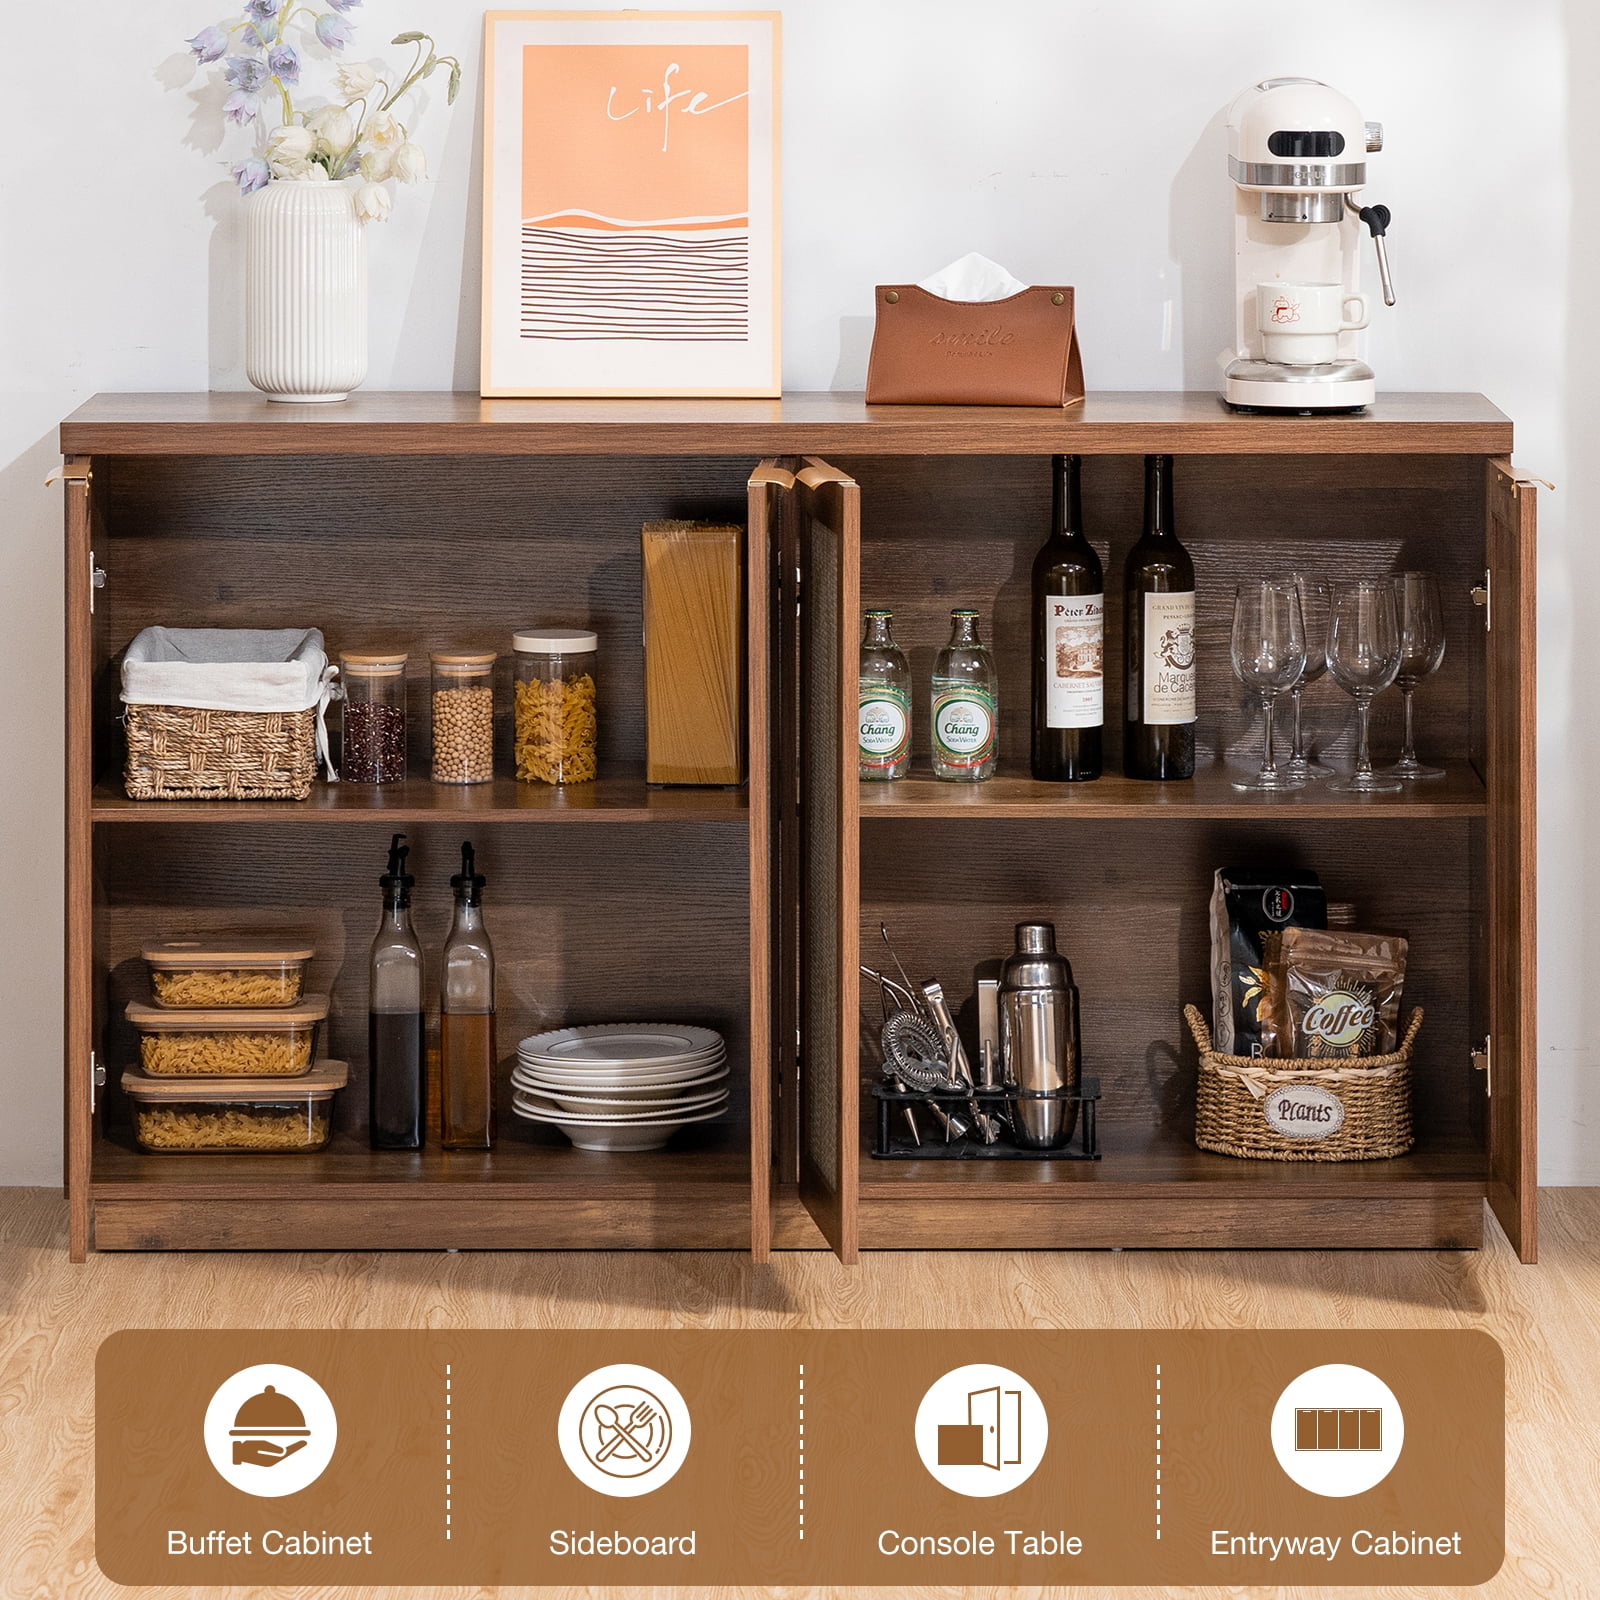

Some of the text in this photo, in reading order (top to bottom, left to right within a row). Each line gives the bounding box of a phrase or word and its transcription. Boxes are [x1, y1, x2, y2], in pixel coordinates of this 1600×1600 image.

[607, 62, 754, 152] Life
[928, 325, 1014, 346] smile
[1054, 604, 1083, 617] Peter
[1153, 681, 1168, 693] de
[860, 723, 895, 736] Chang
[944, 722, 979, 736] Chang
[1305, 1004, 1373, 1035] Coffee
[1278, 1099, 1332, 1122] Plants
